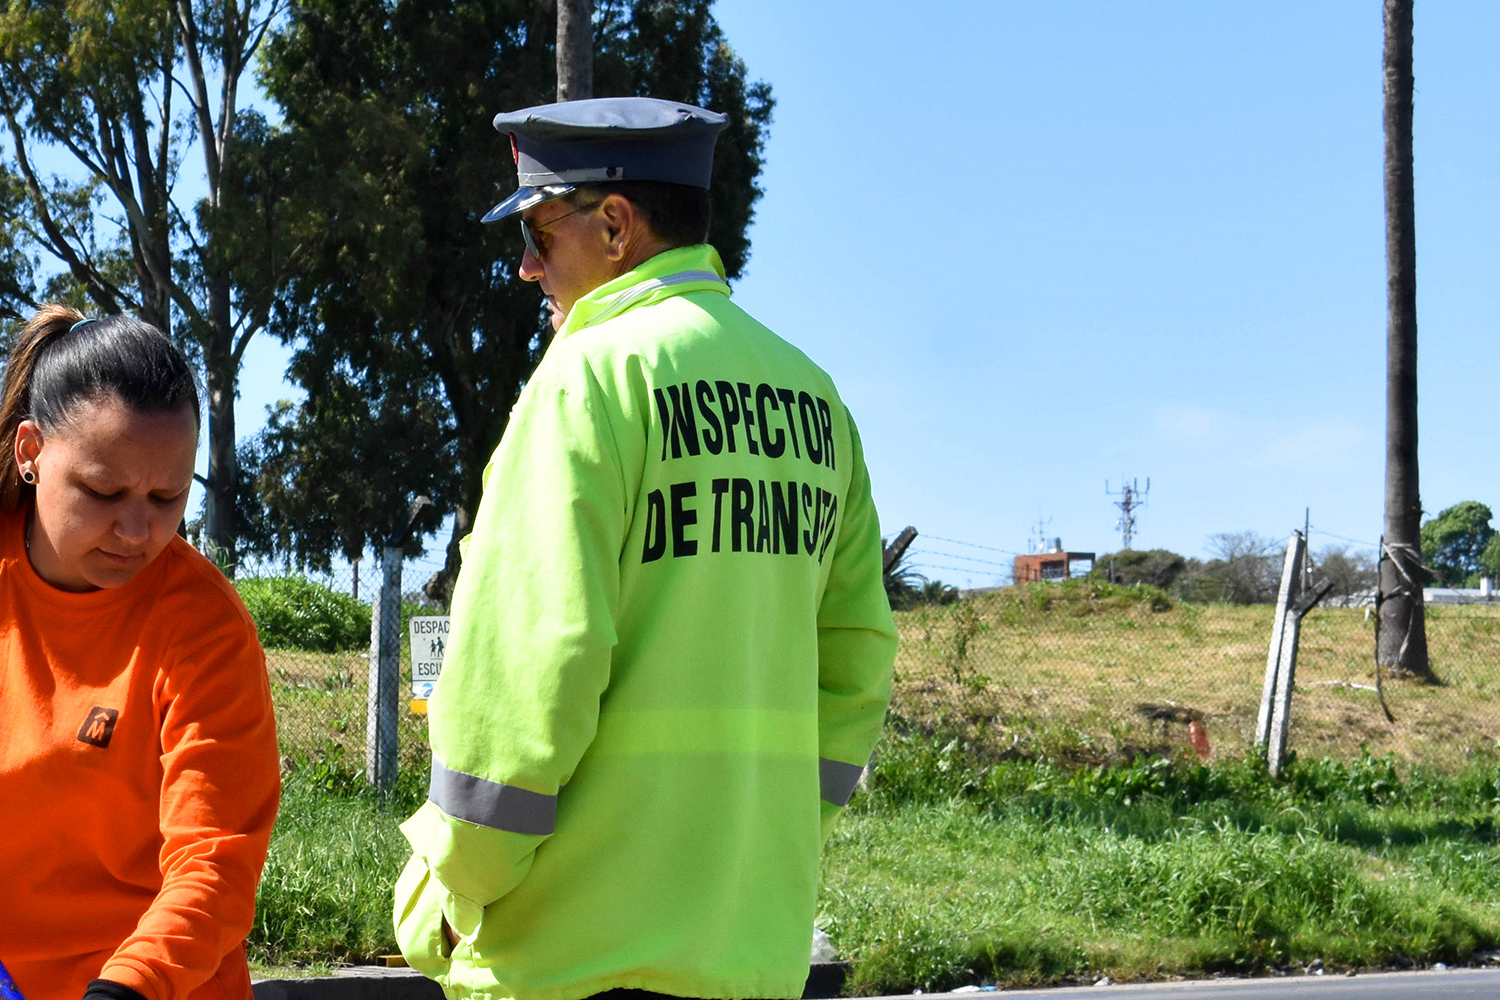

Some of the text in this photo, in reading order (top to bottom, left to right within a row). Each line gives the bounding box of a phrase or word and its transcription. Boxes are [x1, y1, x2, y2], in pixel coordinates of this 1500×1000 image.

[653, 379, 836, 471] INSPECTOR
[641, 477, 838, 566] DE TRANSITO
